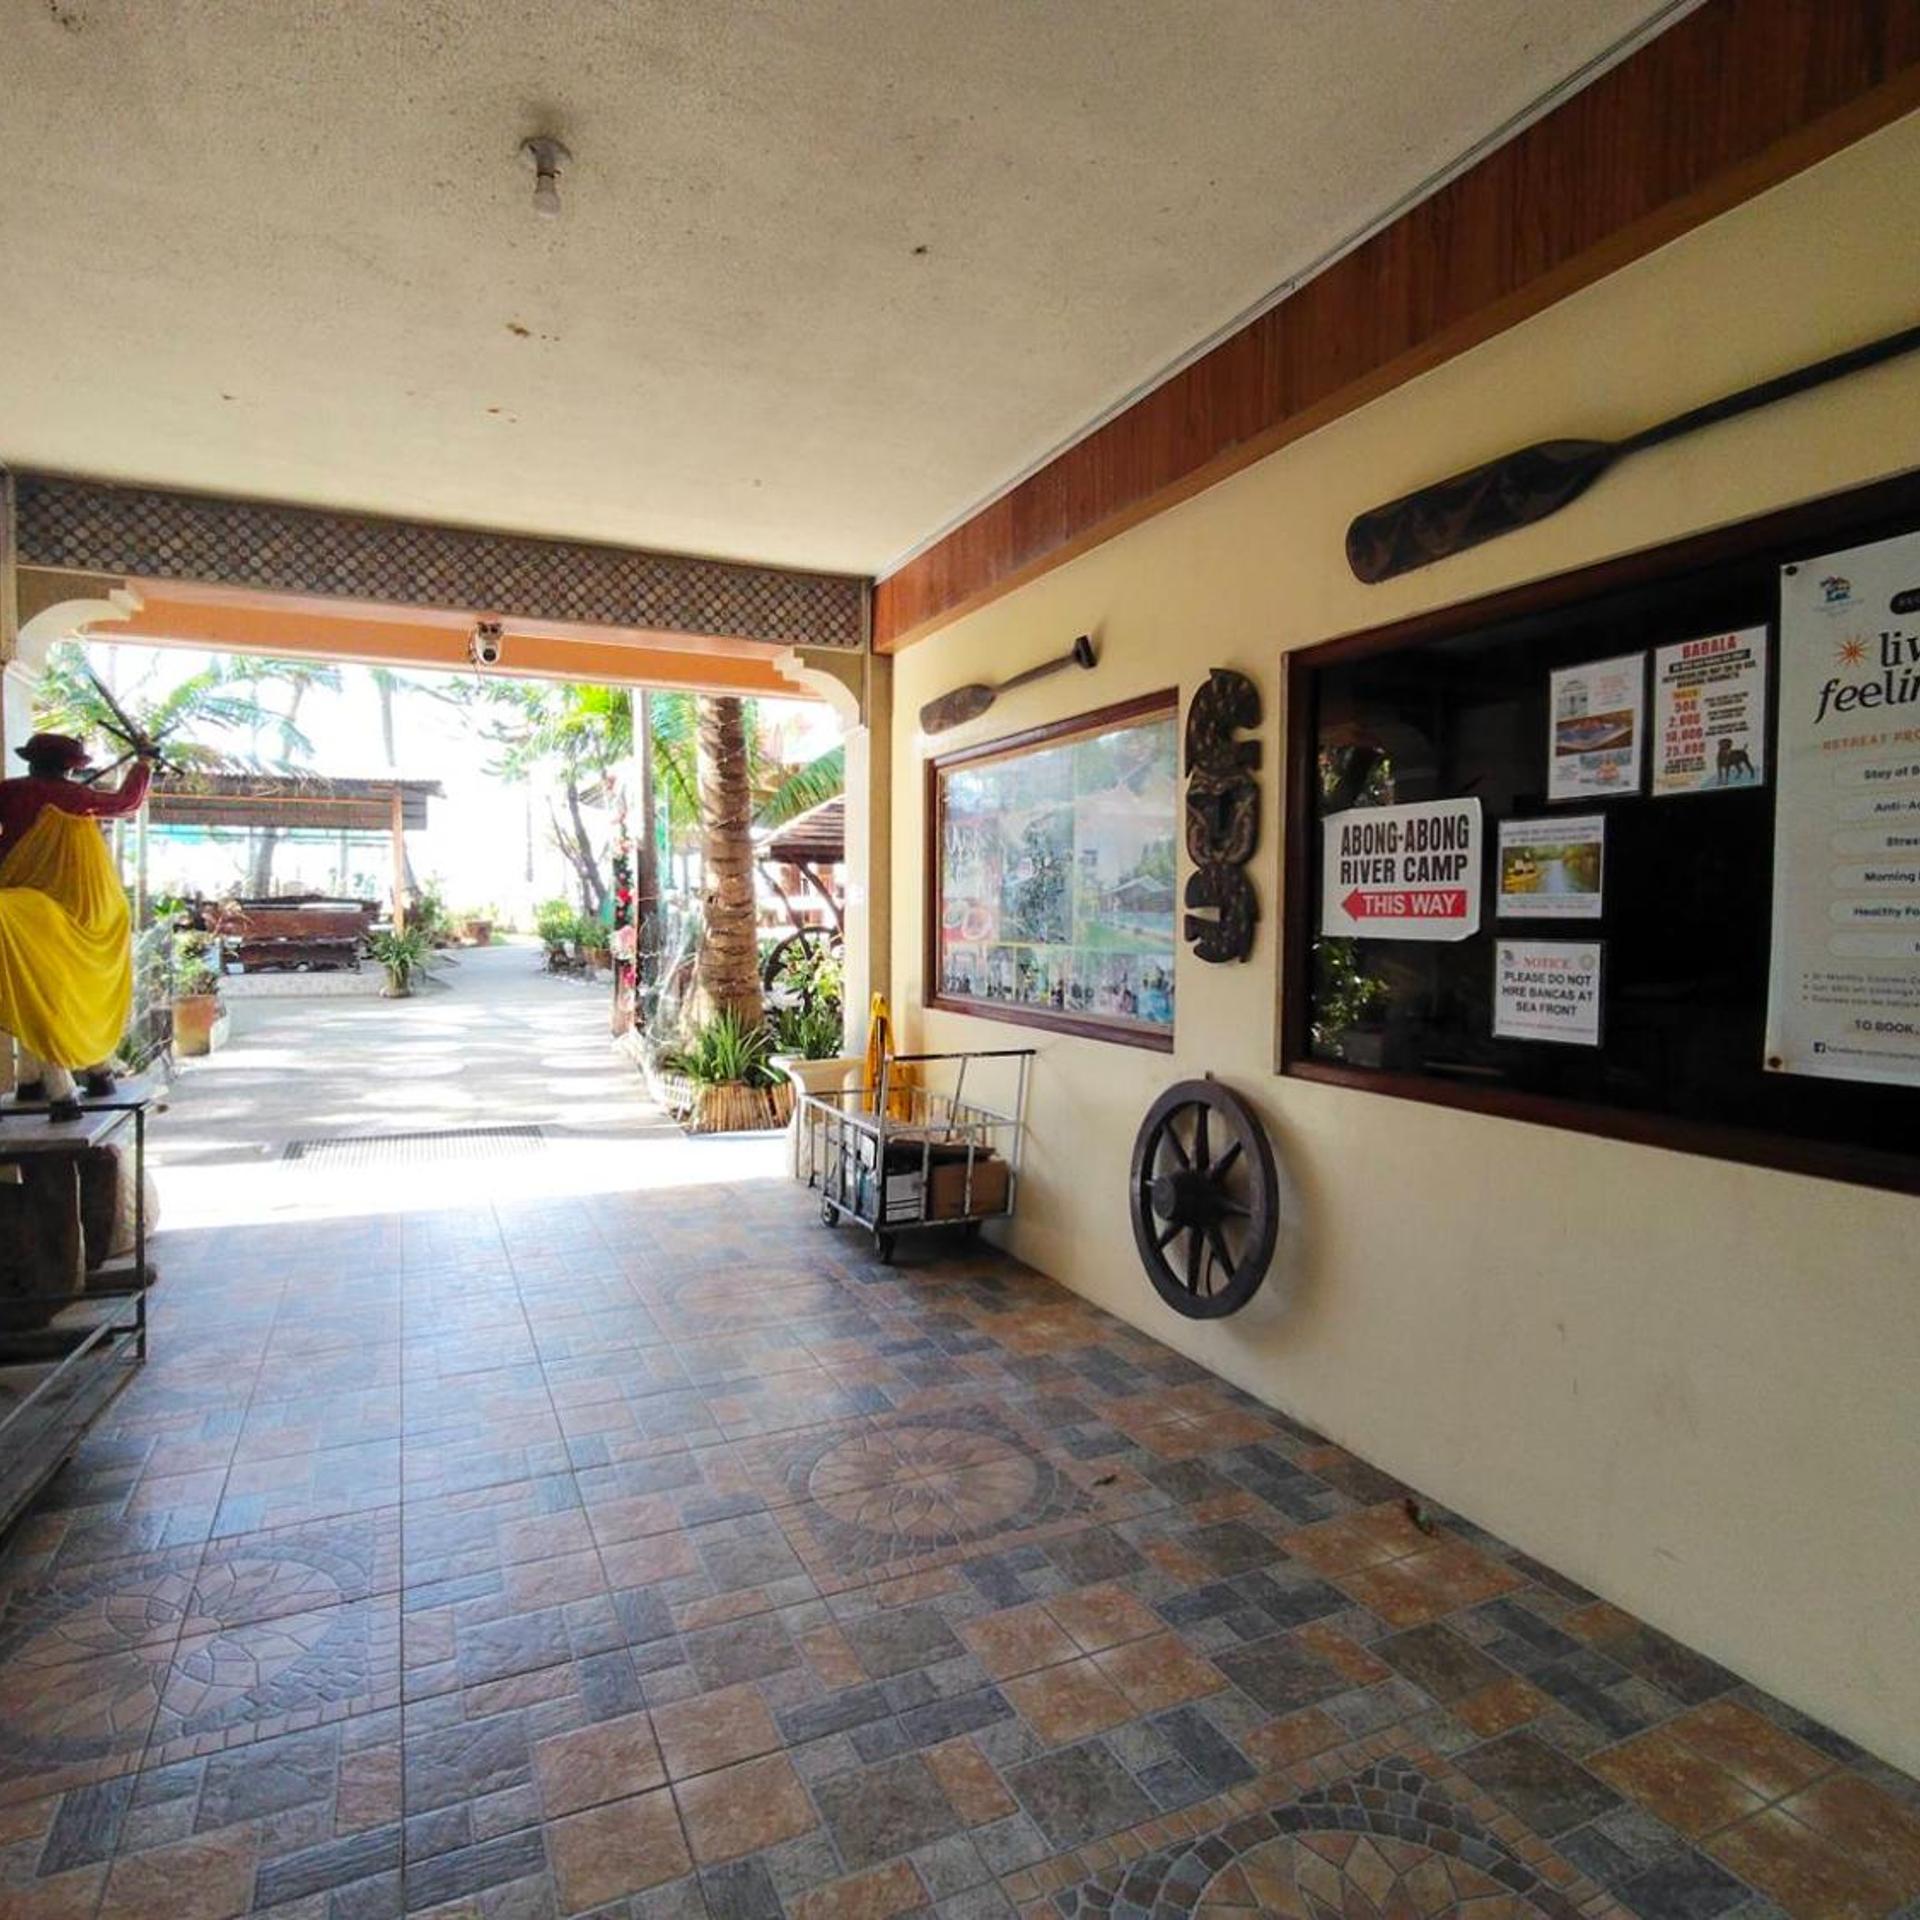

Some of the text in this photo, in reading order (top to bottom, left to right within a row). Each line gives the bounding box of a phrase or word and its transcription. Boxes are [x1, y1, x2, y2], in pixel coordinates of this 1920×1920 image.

[1823, 734, 1888, 750] RETREAT
[1341, 814, 1469, 856] ABONG-ABONG
[1340, 855, 1468, 885] RIVER CAMP
[1864, 871, 1915, 883] Morning
[1362, 893, 1457, 915] THIS WAY
[1854, 907, 1901, 918] Healthy
[1504, 971, 1592, 987] PLEASE DO NOT
[1503, 985, 1594, 1002] HIRE BANCAS AT
[1516, 1001, 1577, 1016] SEA FRONT
[1855, 1019, 1873, 1032] TO
